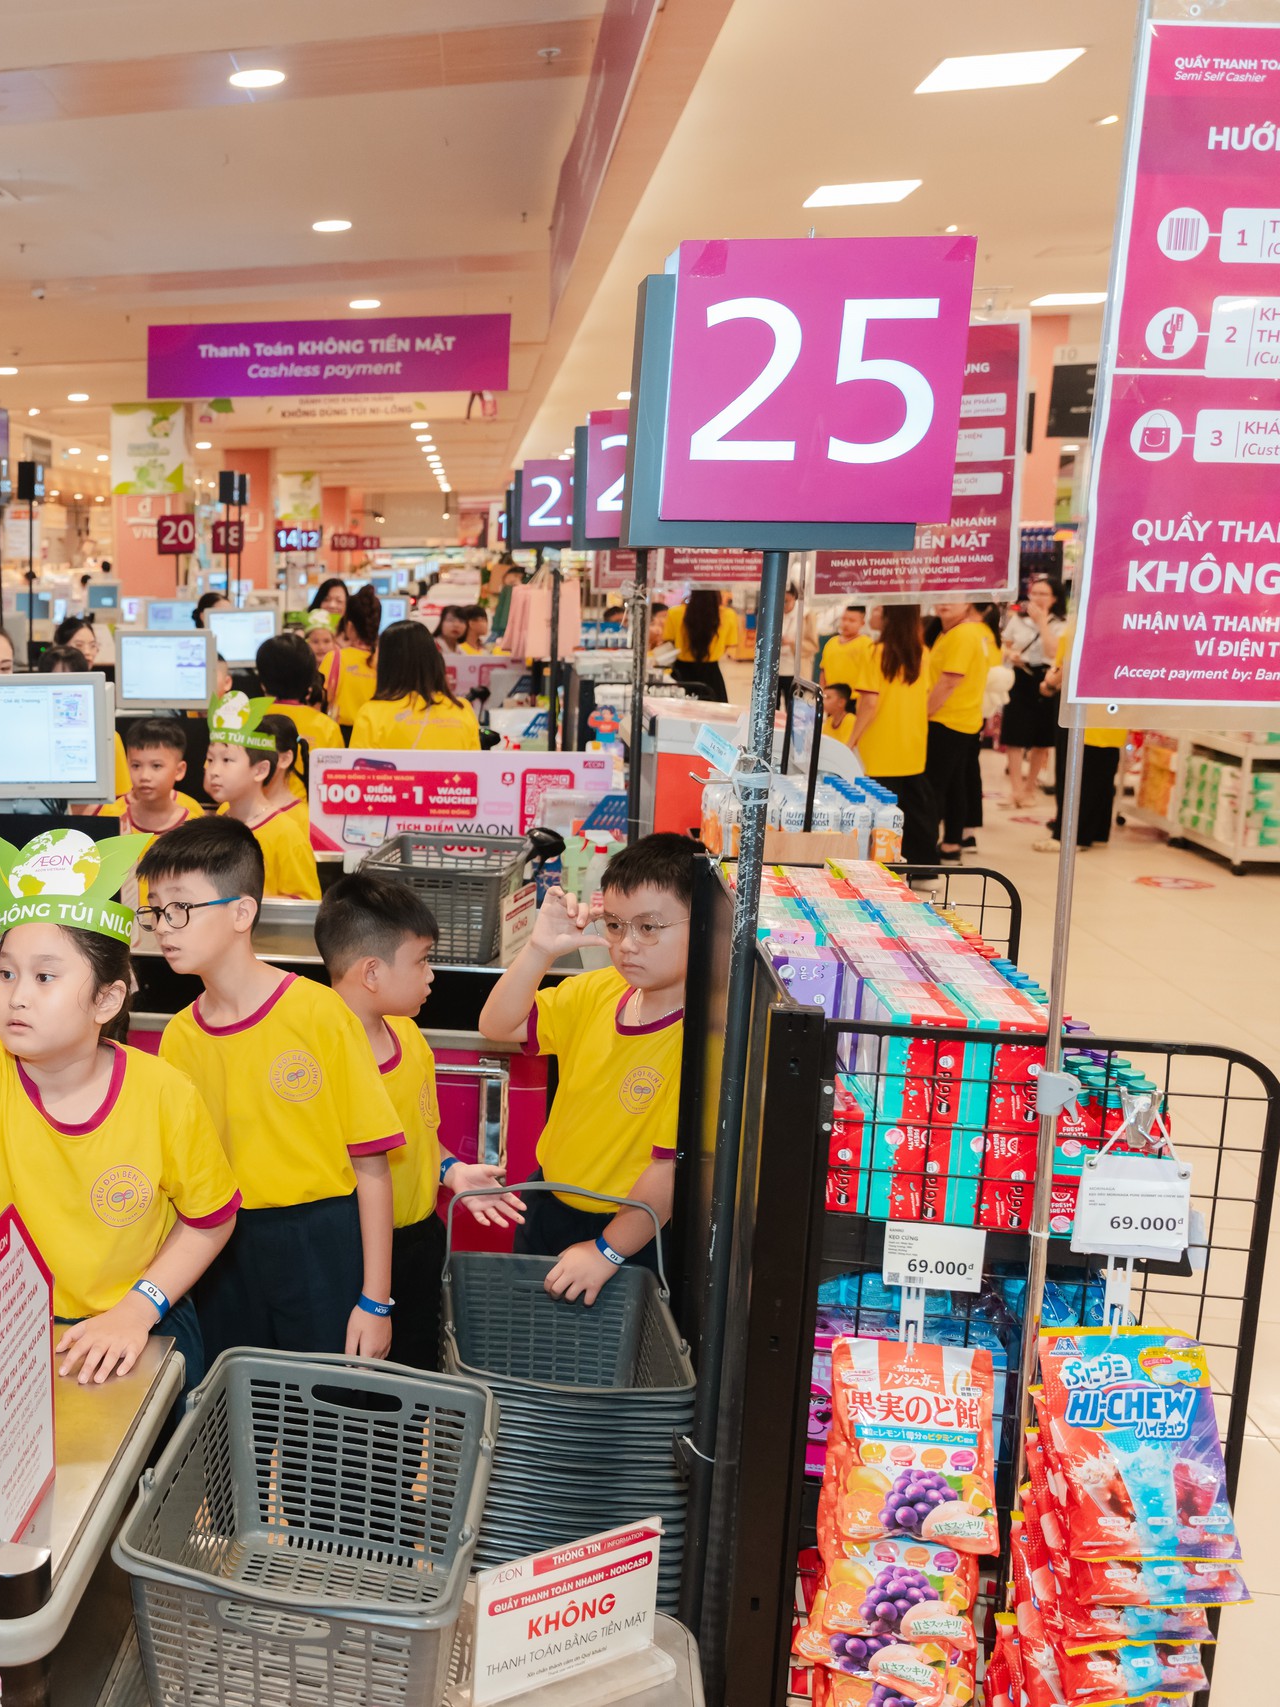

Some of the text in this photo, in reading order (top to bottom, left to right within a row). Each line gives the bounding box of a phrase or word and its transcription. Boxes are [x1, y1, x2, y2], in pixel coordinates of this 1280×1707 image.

[1213, 59, 1258, 70] THANH
[1174, 71, 1267, 83] Semi Self Cashier
[1237, 230, 1248, 246] 1
[1224, 326, 1238, 343] 2
[198, 342, 250, 358] Thanh
[253, 339, 294, 357] Toán
[297, 334, 365, 356] KHÔNG
[415, 334, 456, 355] MẶT
[247, 361, 403, 380] Cashless payment
[689, 296, 940, 464] 25
[1209, 430, 1223, 446] 3
[161, 520, 195, 546] 20
[1126, 552, 1280, 594] KHÔNG
[1122, 611, 1279, 634] NHẬN VÀ THANH
[1194, 638, 1264, 661] VÍ ĐIỆN
[1114, 665, 1252, 682] (Accept payment by:
[318, 783, 361, 804] 100
[363, 793, 397, 804] WAON
[412, 785, 424, 805] 1
[428, 795, 478, 805] VOUCHER
[437, 786, 471, 796] WAON
[456, 823, 514, 836] WAON
[58, 901, 94, 924] TÚI
[100, 910, 133, 937] NILO
[883, 1373, 941, 1387] ノンシュガー
[848, 1390, 981, 1430] 果実のど飴
[1067, 1387, 1198, 1425] HI-CHEW
[1135, 1421, 1188, 1438] ハイチュウ
[552, 1531, 645, 1566] THÔNG TIN INFORMATION
[520, 1587, 550, 1607] THANH
[550, 1578, 575, 1597] TOÁN
[575, 1571, 605, 1588] NHANH
[610, 1556, 649, 1577] NONCASH
[526, 1592, 617, 1640] KHÔNG
[486, 1653, 527, 1677] THANH
[529, 1643, 562, 1663] TOÁN
[564, 1628, 598, 1651] BẰNG
[600, 1619, 622, 1638] TIỀN
[623, 1610, 648, 1630] MẶT
